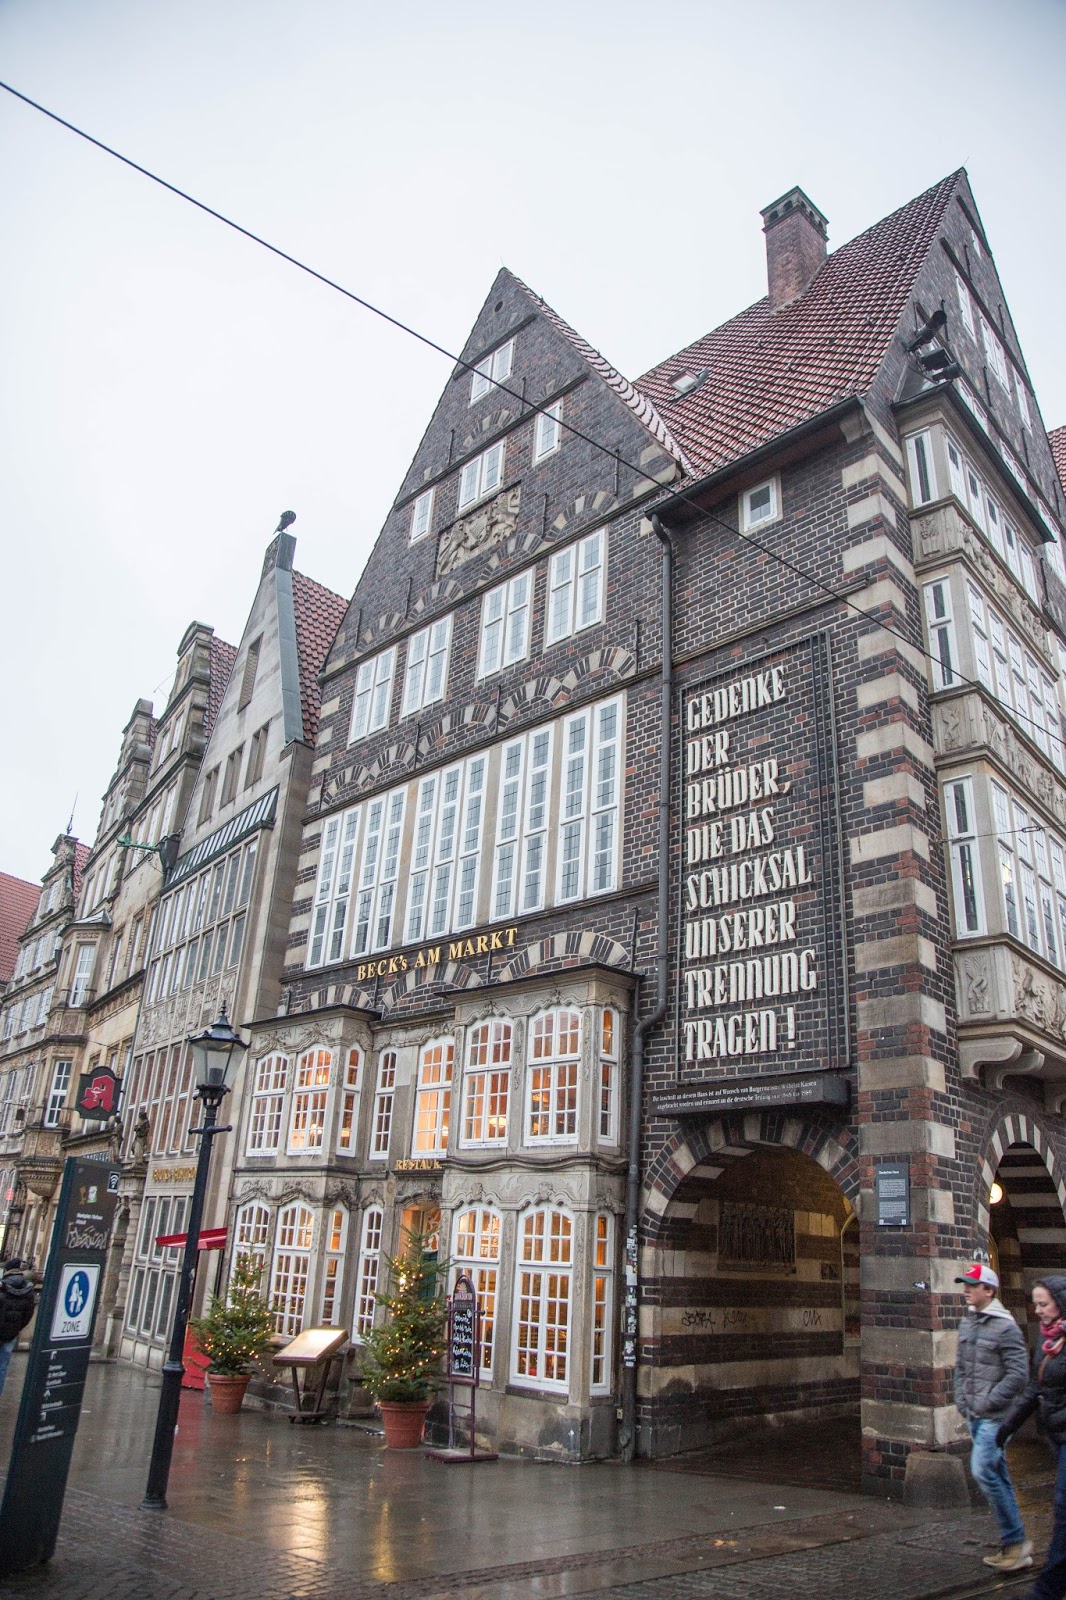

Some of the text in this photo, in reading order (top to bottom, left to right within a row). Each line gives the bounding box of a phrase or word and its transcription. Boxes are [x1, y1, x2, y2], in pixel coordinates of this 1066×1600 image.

[687, 666, 786, 731] GEDENKE
[687, 730, 730, 775] DER
[687, 759, 791, 819] BRÜDER,
[687, 807, 774, 865] DIE DAS
[686, 846, 812, 911] SCHICKSAL
[414, 947, 441, 968] AM
[448, 928, 518, 960] MARKT
[685, 901, 796, 959] UNSERER
[685, 949, 817, 1009] TRENNUNG
[61, 1321, 81, 1333] ZONE
